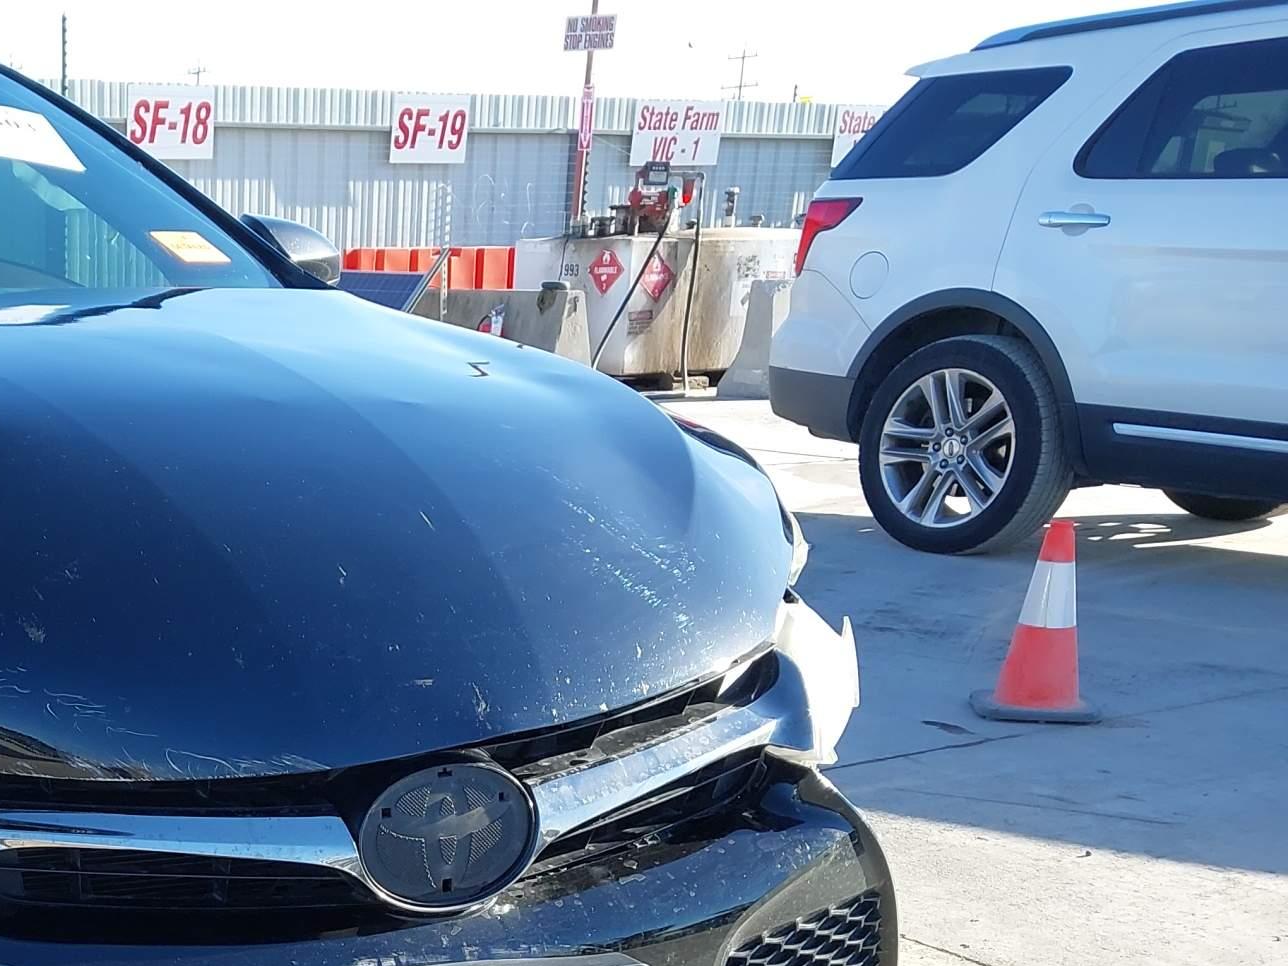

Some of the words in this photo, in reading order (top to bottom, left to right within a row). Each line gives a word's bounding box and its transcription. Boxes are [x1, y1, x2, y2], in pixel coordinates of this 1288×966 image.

[567, 17, 579, 33] NO
[580, 16, 615, 32] SMOKING
[564, 34, 583, 50] STOP
[584, 32, 614, 49] ENGINES
[130, 99, 211, 145] SF-18
[394, 107, 466, 150] SF-19
[638, 105, 679, 131] State
[681, 106, 720, 131] Farm
[839, 110, 876, 134] State
[652, 136, 677, 162] VIC
[692, 137, 700, 161] 1
